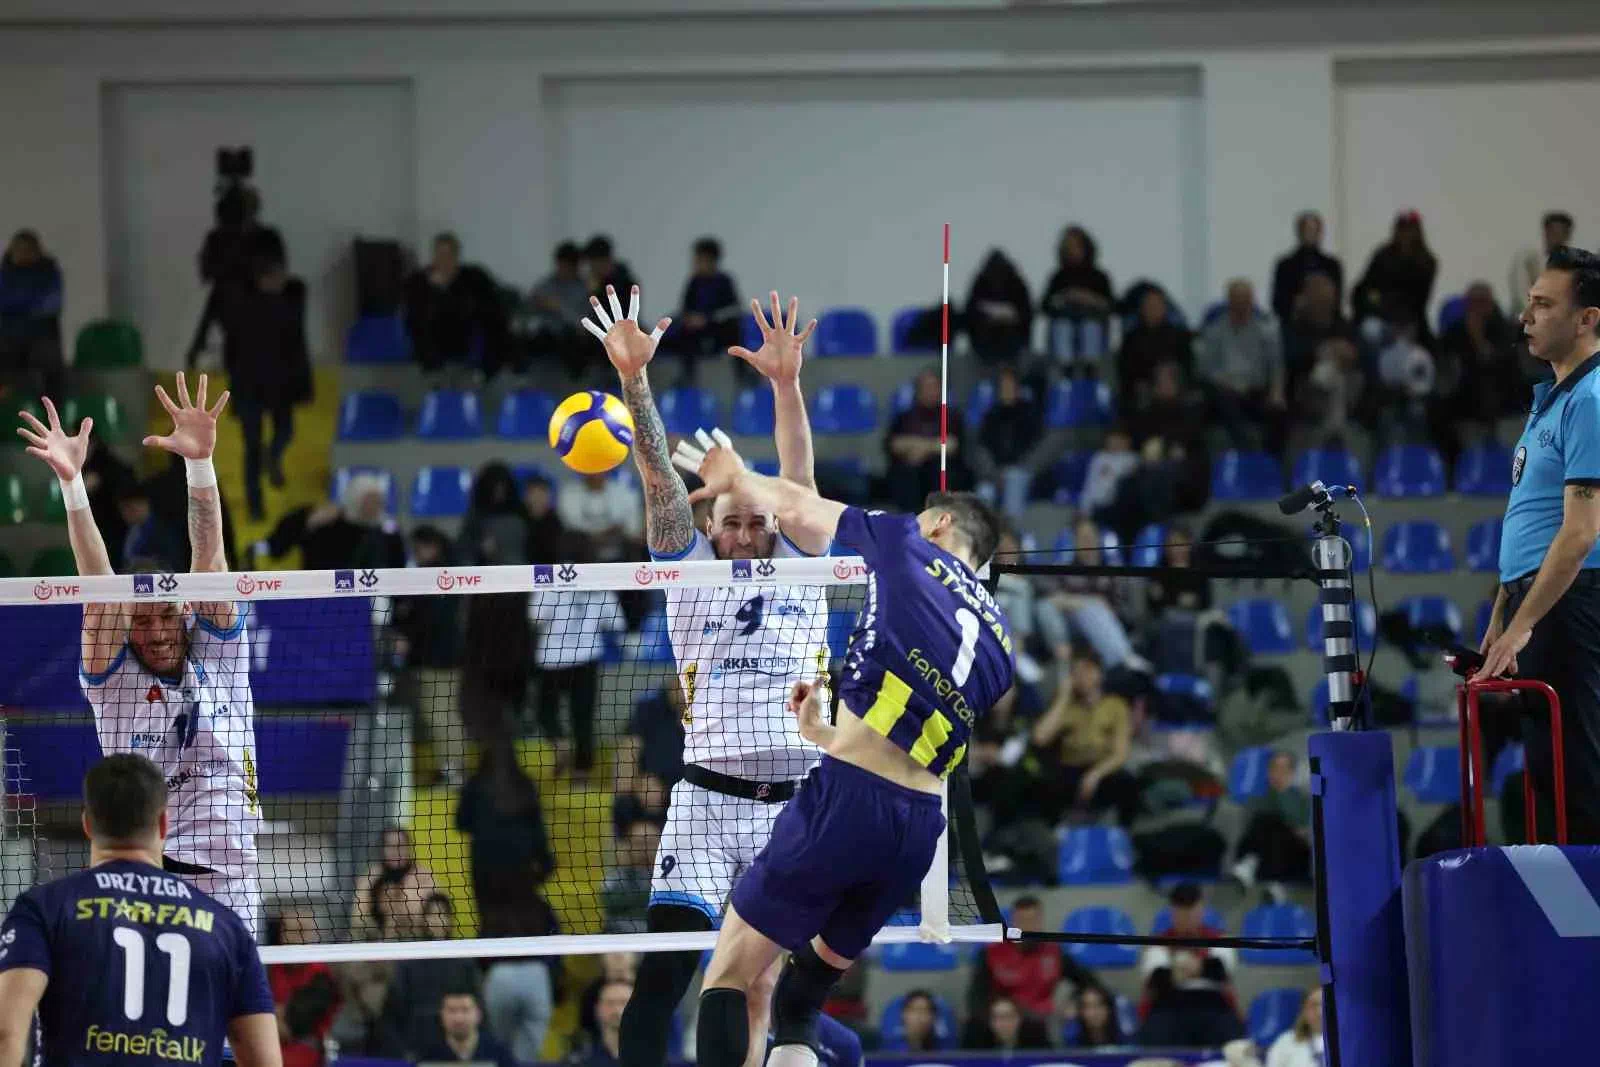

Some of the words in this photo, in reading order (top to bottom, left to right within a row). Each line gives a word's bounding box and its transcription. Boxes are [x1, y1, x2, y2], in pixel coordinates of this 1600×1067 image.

[255, 580, 282, 592] TVF
[456, 575, 482, 587] TVF
[654, 570, 680, 581] TVF
[54, 585, 80, 597] TVF
[736, 594, 764, 636] 9
[952, 607, 980, 687] 1
[660, 855, 676, 878] 9
[95, 872, 192, 900] DRZYZGA
[113, 926, 191, 1027] 11
[86, 1024, 206, 1065] fenertalk
